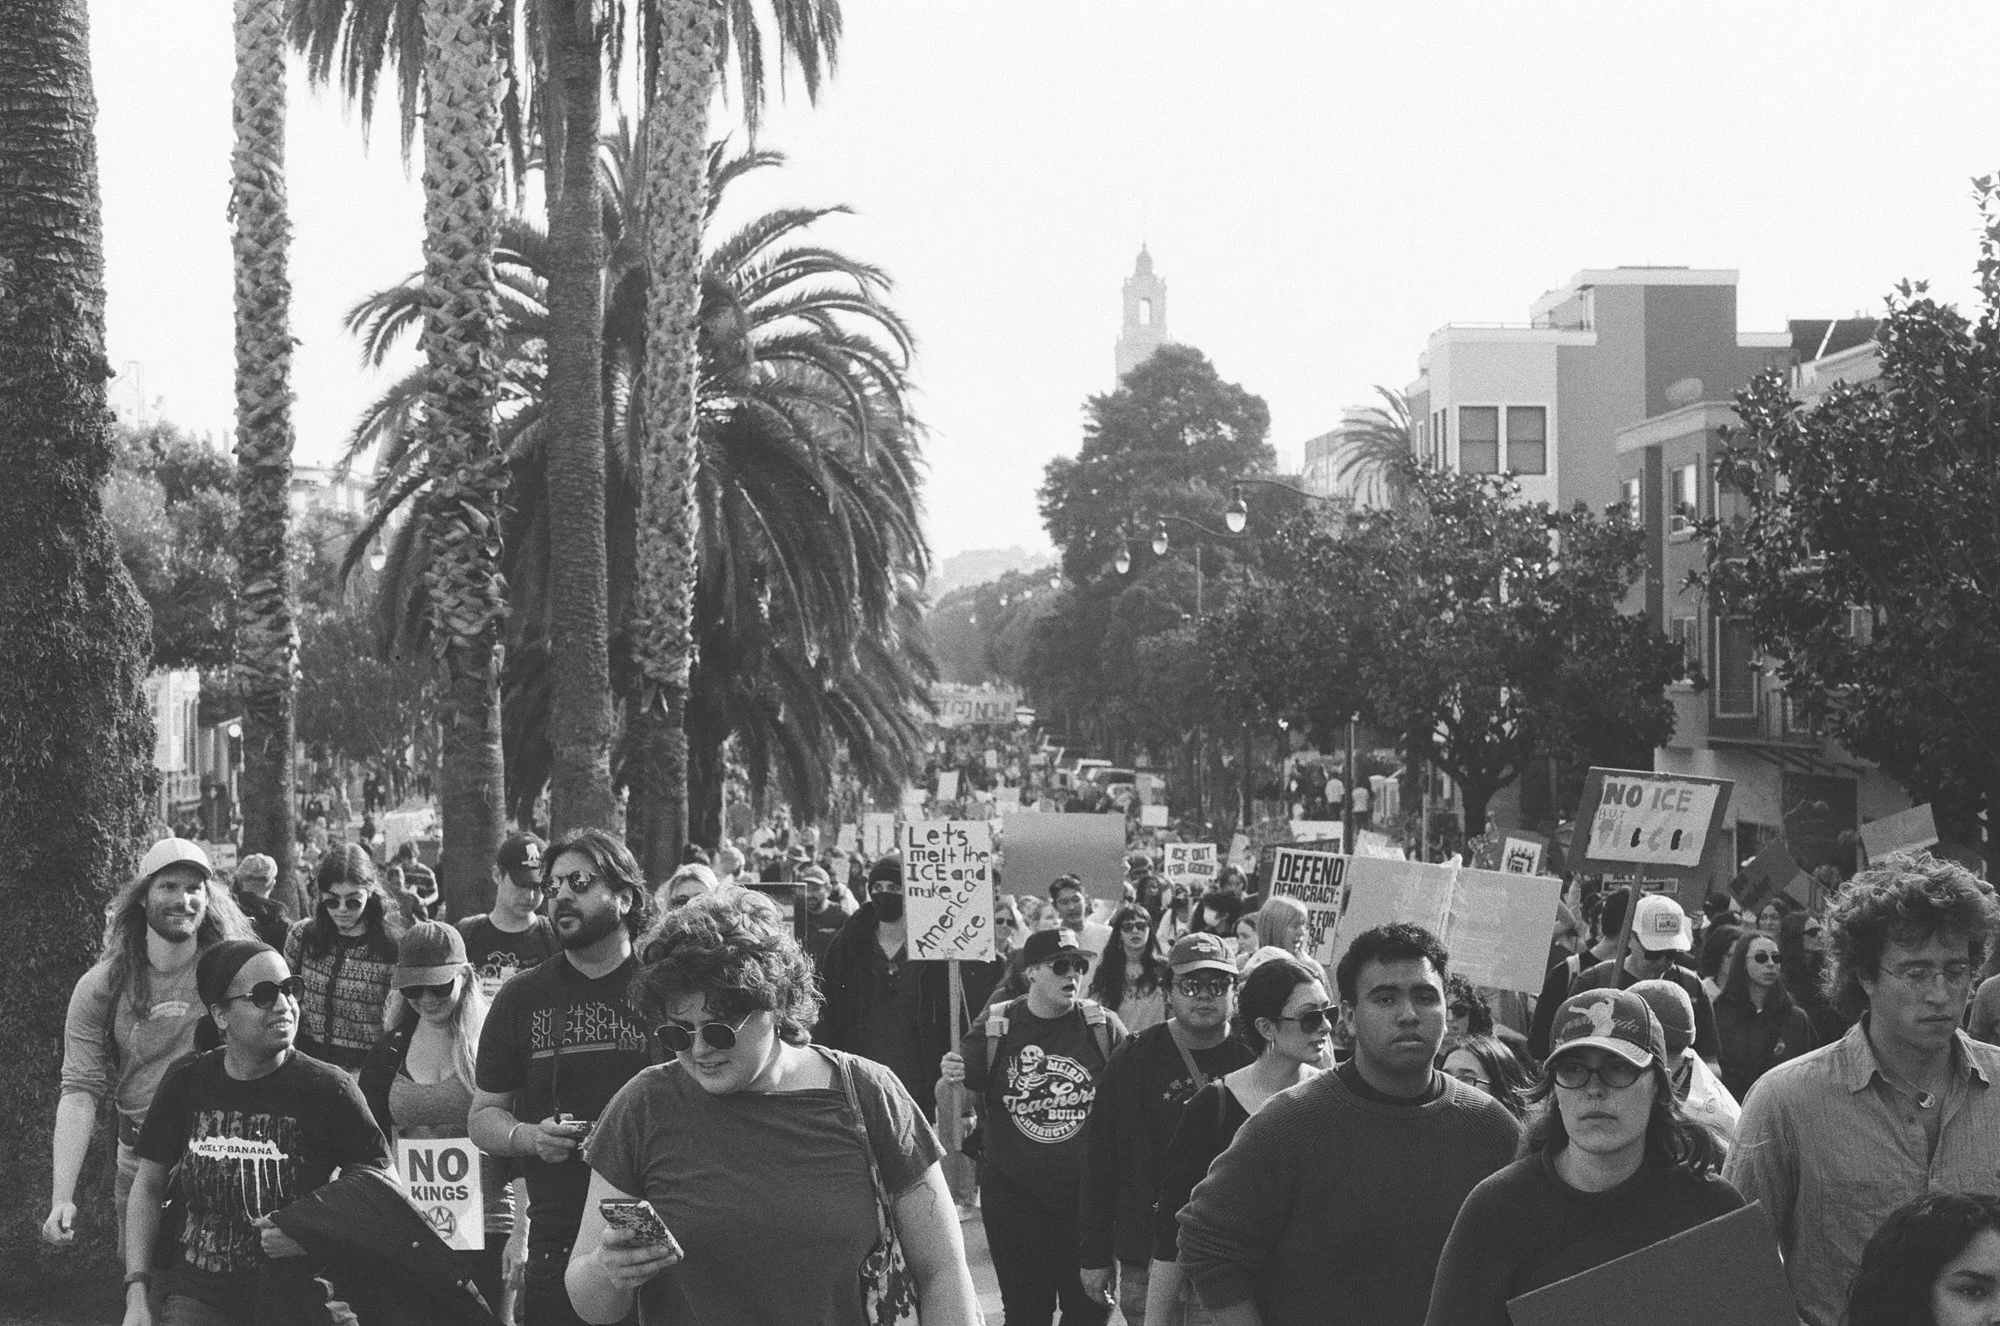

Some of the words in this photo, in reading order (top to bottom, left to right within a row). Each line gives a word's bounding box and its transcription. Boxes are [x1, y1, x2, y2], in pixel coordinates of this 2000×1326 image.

[1603, 783, 1643, 808] NO
[1651, 787, 1693, 812] ICE
[1598, 808, 1625, 820] BUT
[908, 823, 969, 848] Let's
[910, 847, 956, 863] melt
[963, 846, 989, 863] the
[1172, 848, 1187, 861] ICE
[1191, 847, 1210, 861] OUT
[906, 863, 947, 882] ICE
[951, 865, 986, 881] and
[1168, 863, 1186, 876] FOR
[1277, 853, 1345, 886] DEFEND
[908, 881, 952, 900] make
[1273, 882, 1340, 905] DEMOCRACY:
[915, 880, 977, 958] America
[1316, 910, 1337, 929] FOR
[952, 915, 986, 951] nice
[1046, 1059, 1085, 1084] WEIRD
[1003, 1082, 1096, 1115] Teachers
[1047, 1109, 1086, 1120] BUILD
[198, 1144, 273, 1155] MELT-BANANA
[408, 1147, 469, 1182] NO
[411, 1185, 469, 1201] KINGS
